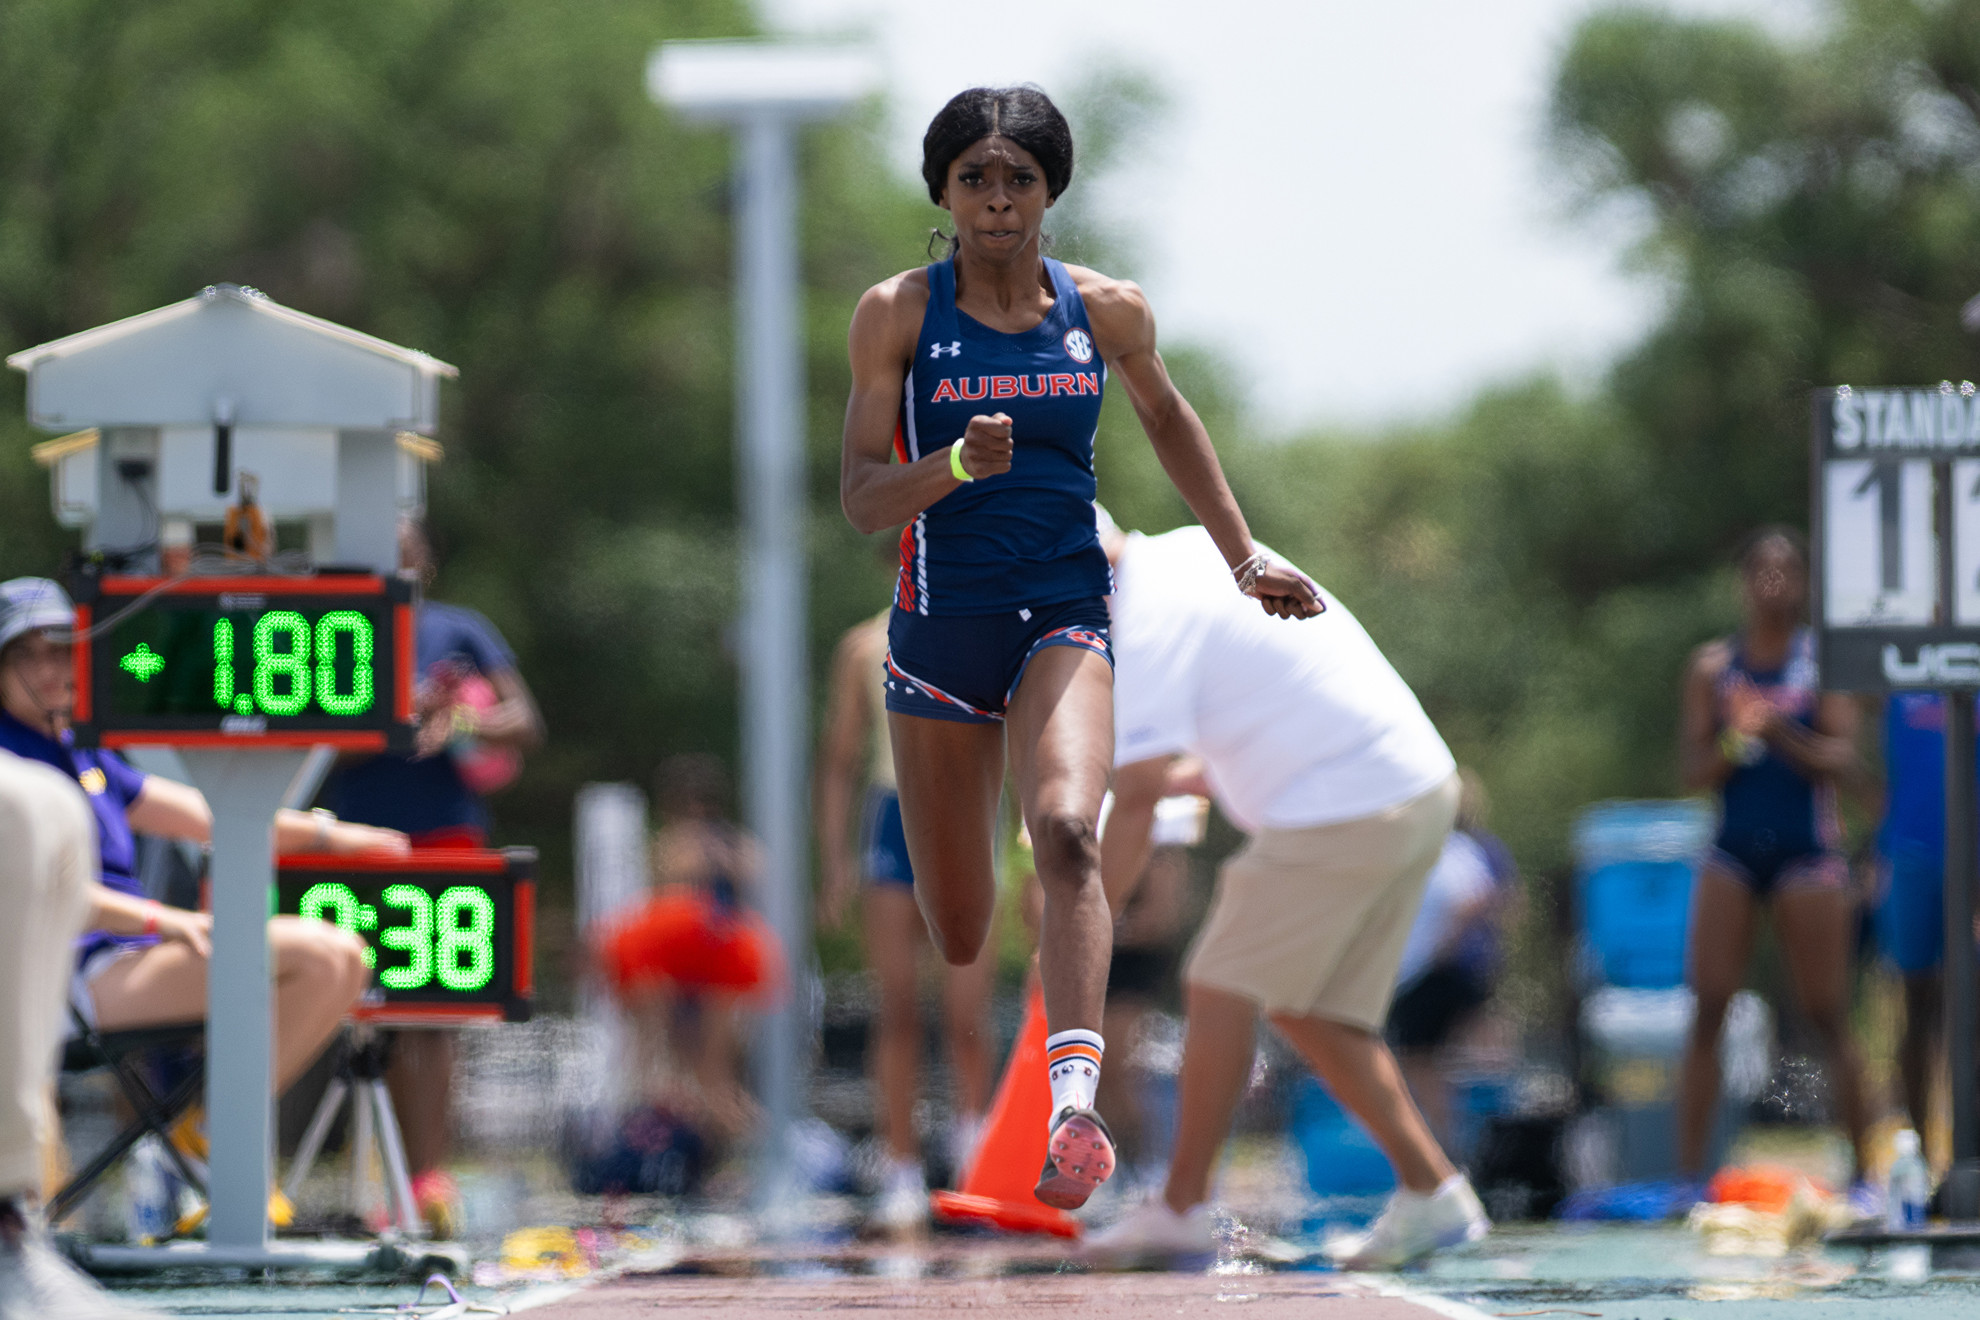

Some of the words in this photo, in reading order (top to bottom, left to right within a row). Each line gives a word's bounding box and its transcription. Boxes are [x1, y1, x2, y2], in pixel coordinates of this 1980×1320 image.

[1065, 329, 1092, 361] SEC
[931, 372, 1099, 403] AUBURN
[213, 610, 375, 716] 1.80
